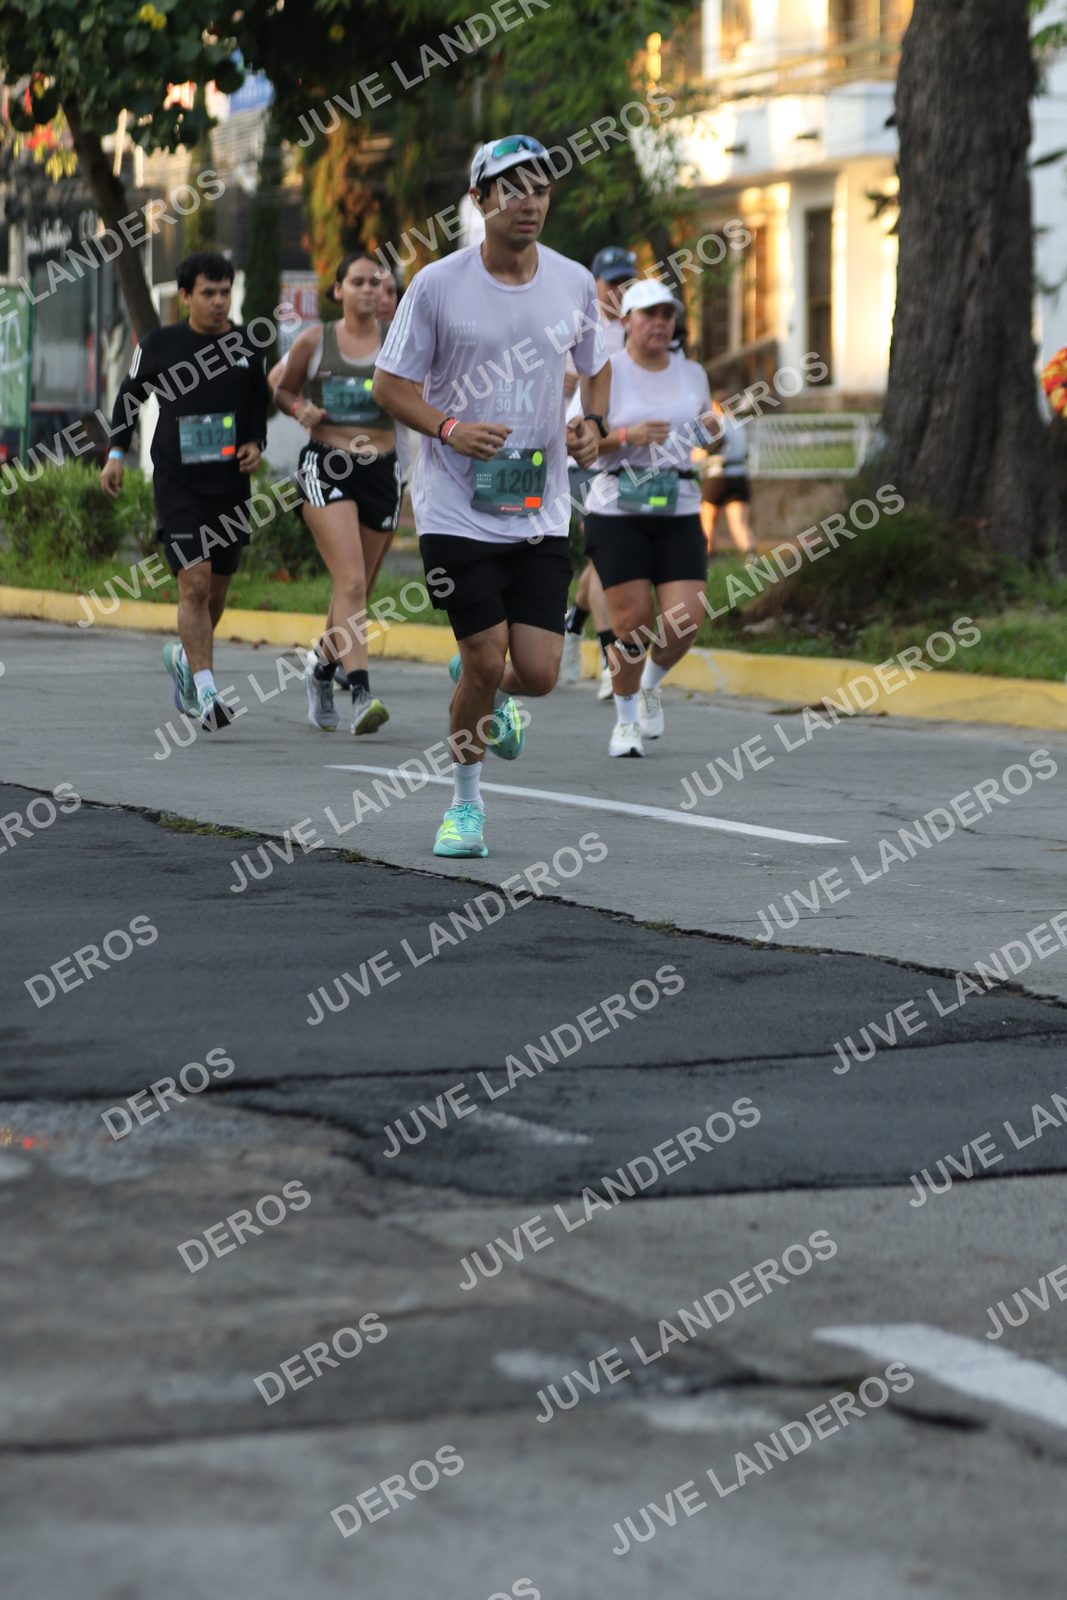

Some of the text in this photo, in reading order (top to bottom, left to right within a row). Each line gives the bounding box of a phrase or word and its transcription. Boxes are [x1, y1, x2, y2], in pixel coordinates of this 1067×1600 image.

[496, 398, 512, 411] 30
[515, 379, 535, 411] K
[496, 467, 543, 494] 1201
